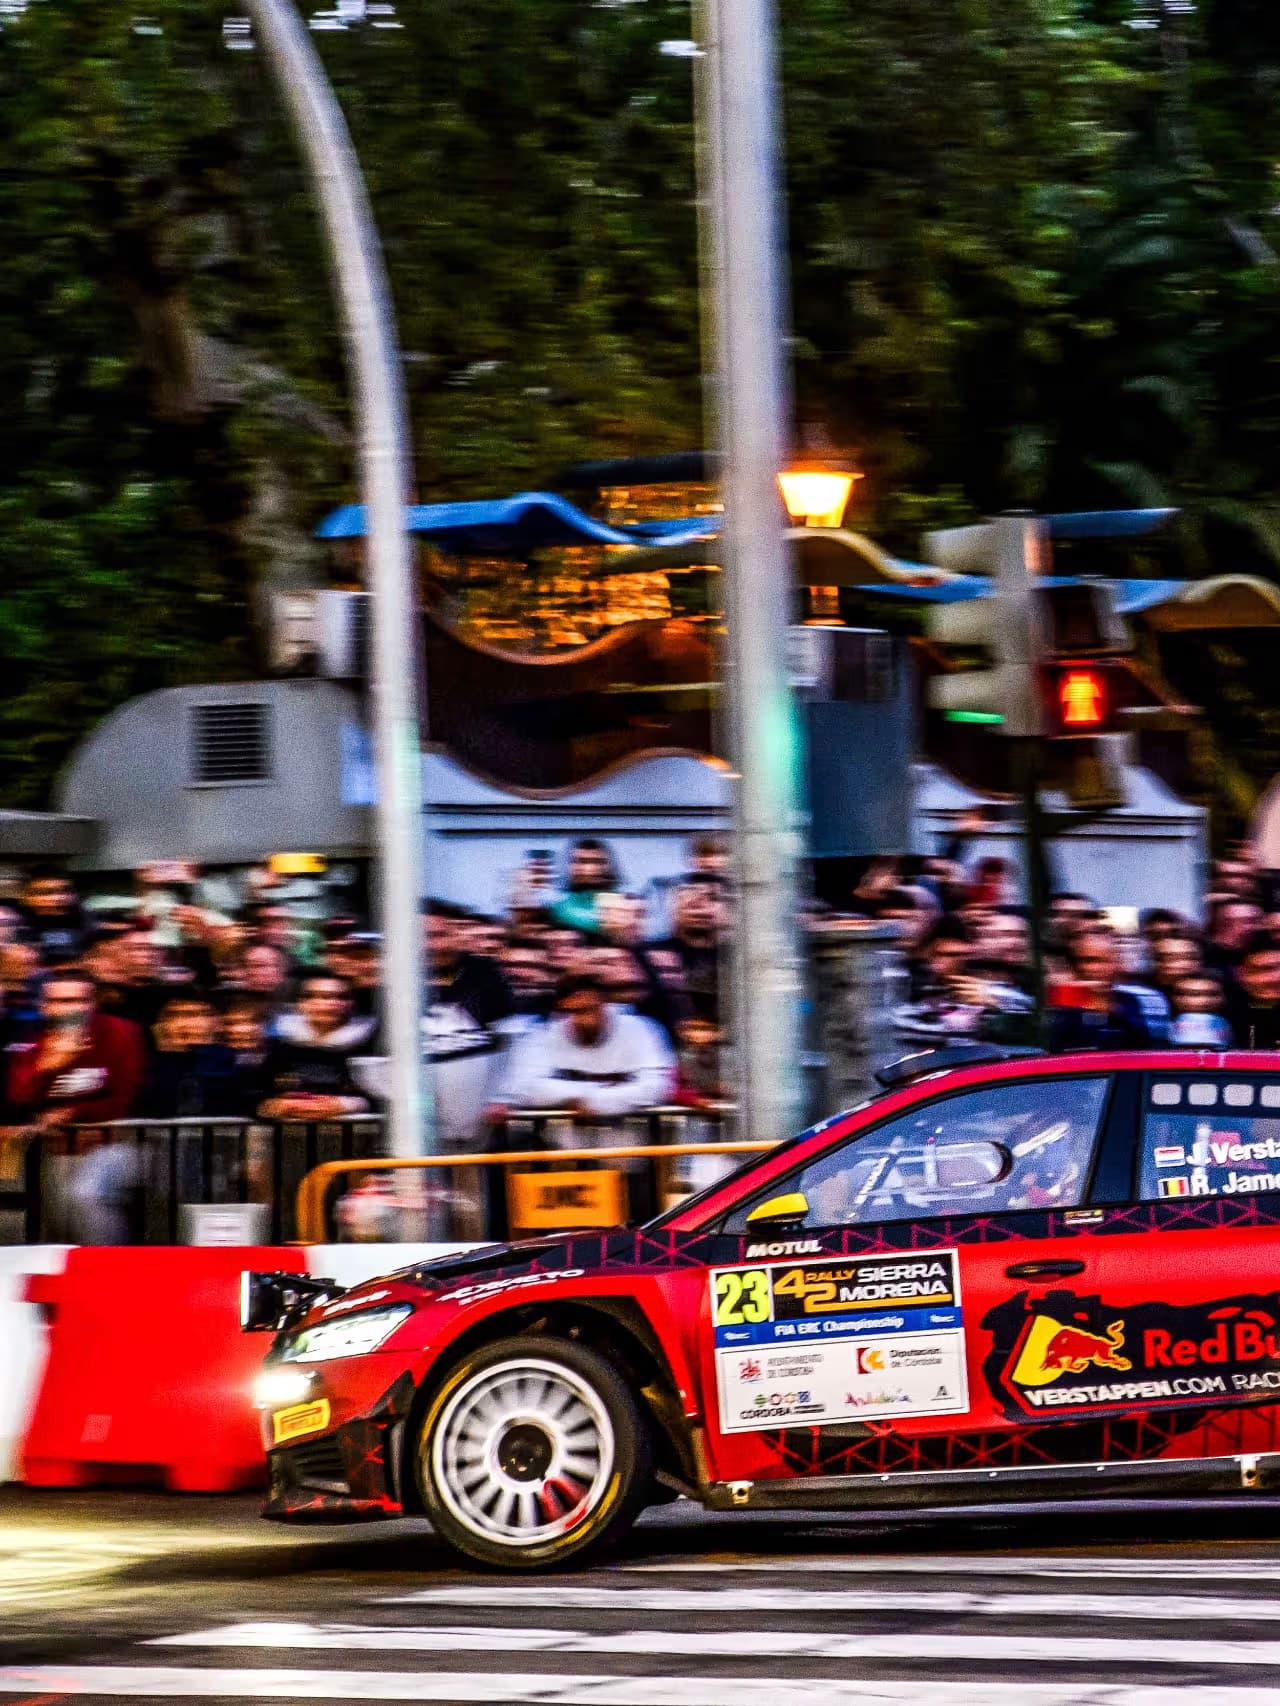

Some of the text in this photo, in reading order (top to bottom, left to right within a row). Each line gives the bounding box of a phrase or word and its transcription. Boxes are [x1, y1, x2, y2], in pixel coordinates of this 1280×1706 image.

[1190, 1170, 1217, 1196] R.
[746, 1239, 823, 1259] MOTUL
[805, 1268, 857, 1284] RALLY
[857, 1262, 947, 1284] SIERRA
[716, 1270, 770, 1326] 23
[840, 1281, 949, 1303] MORENA
[1143, 1323, 1228, 1368] Red
[1024, 1376, 1227, 1407] VERSTAPPEN.COM
